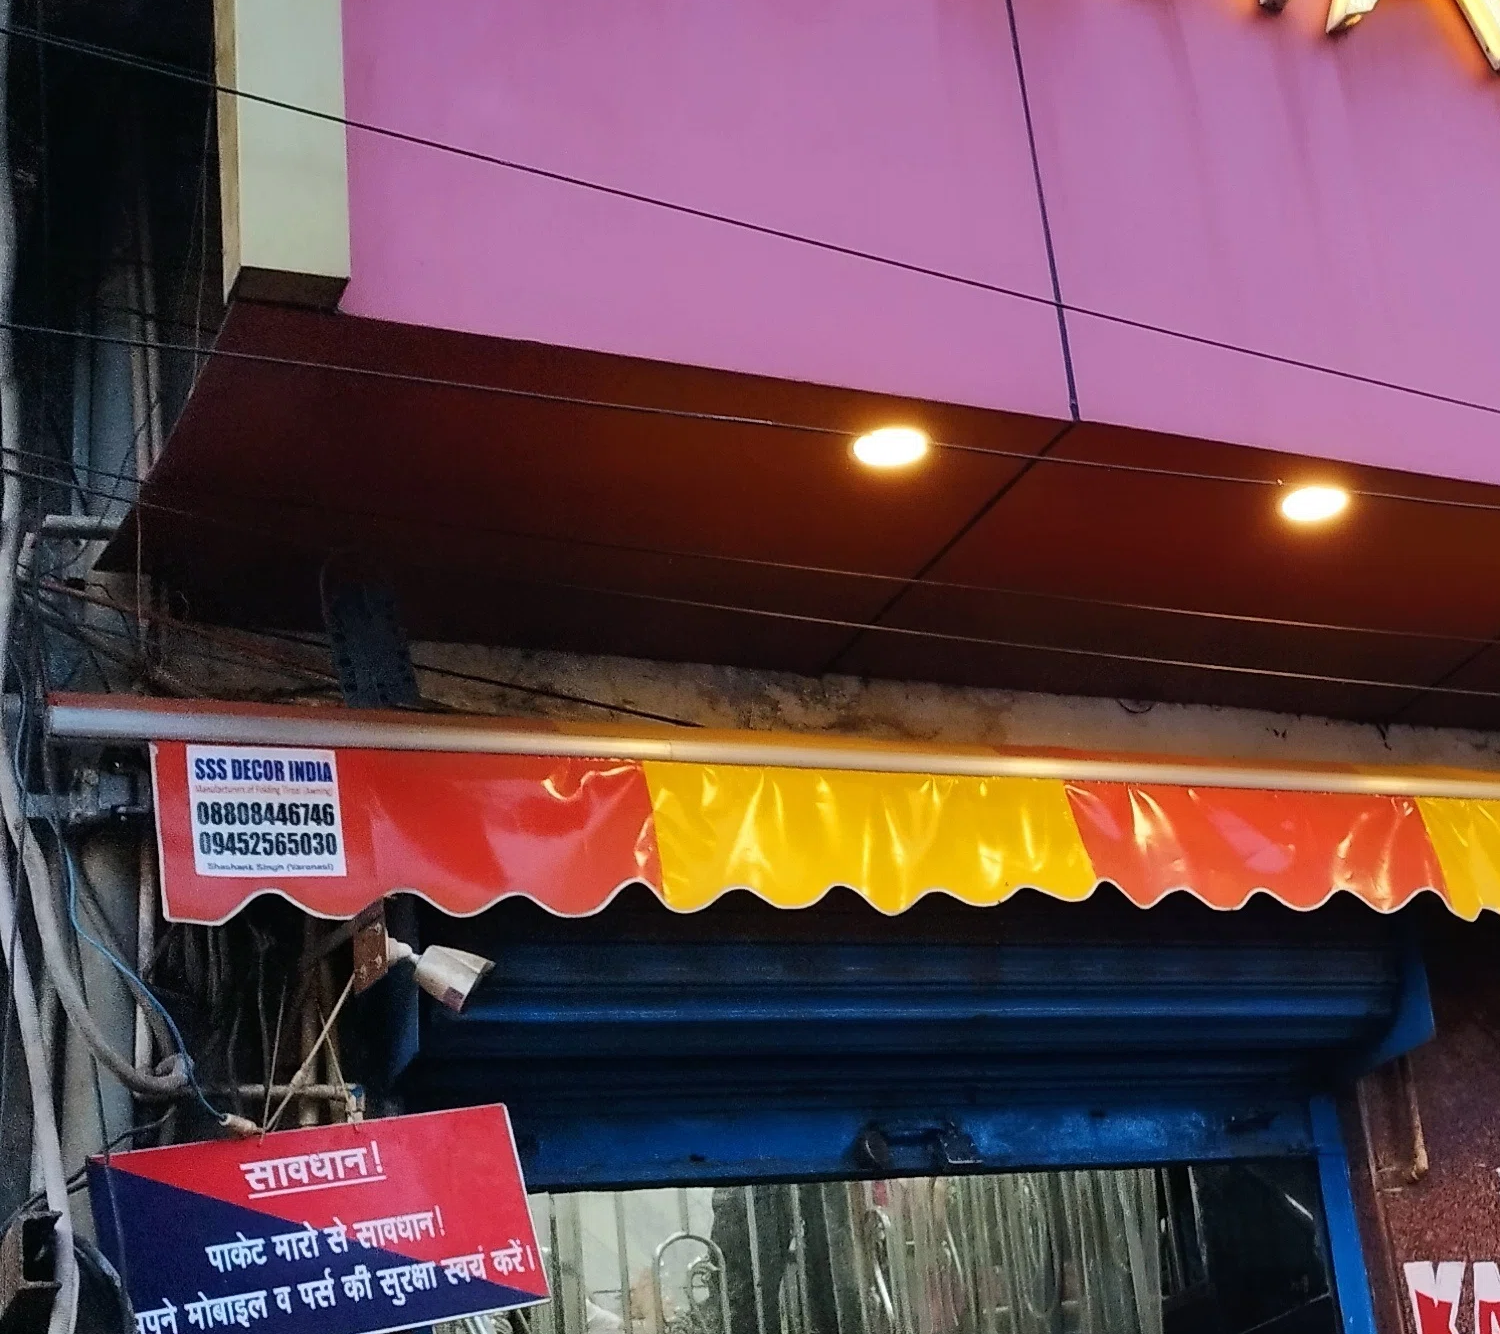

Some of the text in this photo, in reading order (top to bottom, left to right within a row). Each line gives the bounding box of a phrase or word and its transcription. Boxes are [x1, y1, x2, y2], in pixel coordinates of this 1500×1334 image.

[195, 758, 334, 783] SSS DECOR INDIA
[197, 801, 335, 827] 08808446746
[199, 831, 338, 856] 09452565030
[240, 1140, 384, 1191] सावधान!
[205, 1231, 268, 1273] पाकेट
[324, 1217, 349, 1254] से
[353, 1205, 446, 1249] सावधान!
[184, 1291, 268, 1331] मोबाइल
[273, 1286, 292, 1315] व
[297, 1267, 337, 1311] पर्स
[341, 1264, 373, 1303] की
[376, 1261, 438, 1307] सुरक्षा
[440, 1245, 487, 1285] स्वयं
